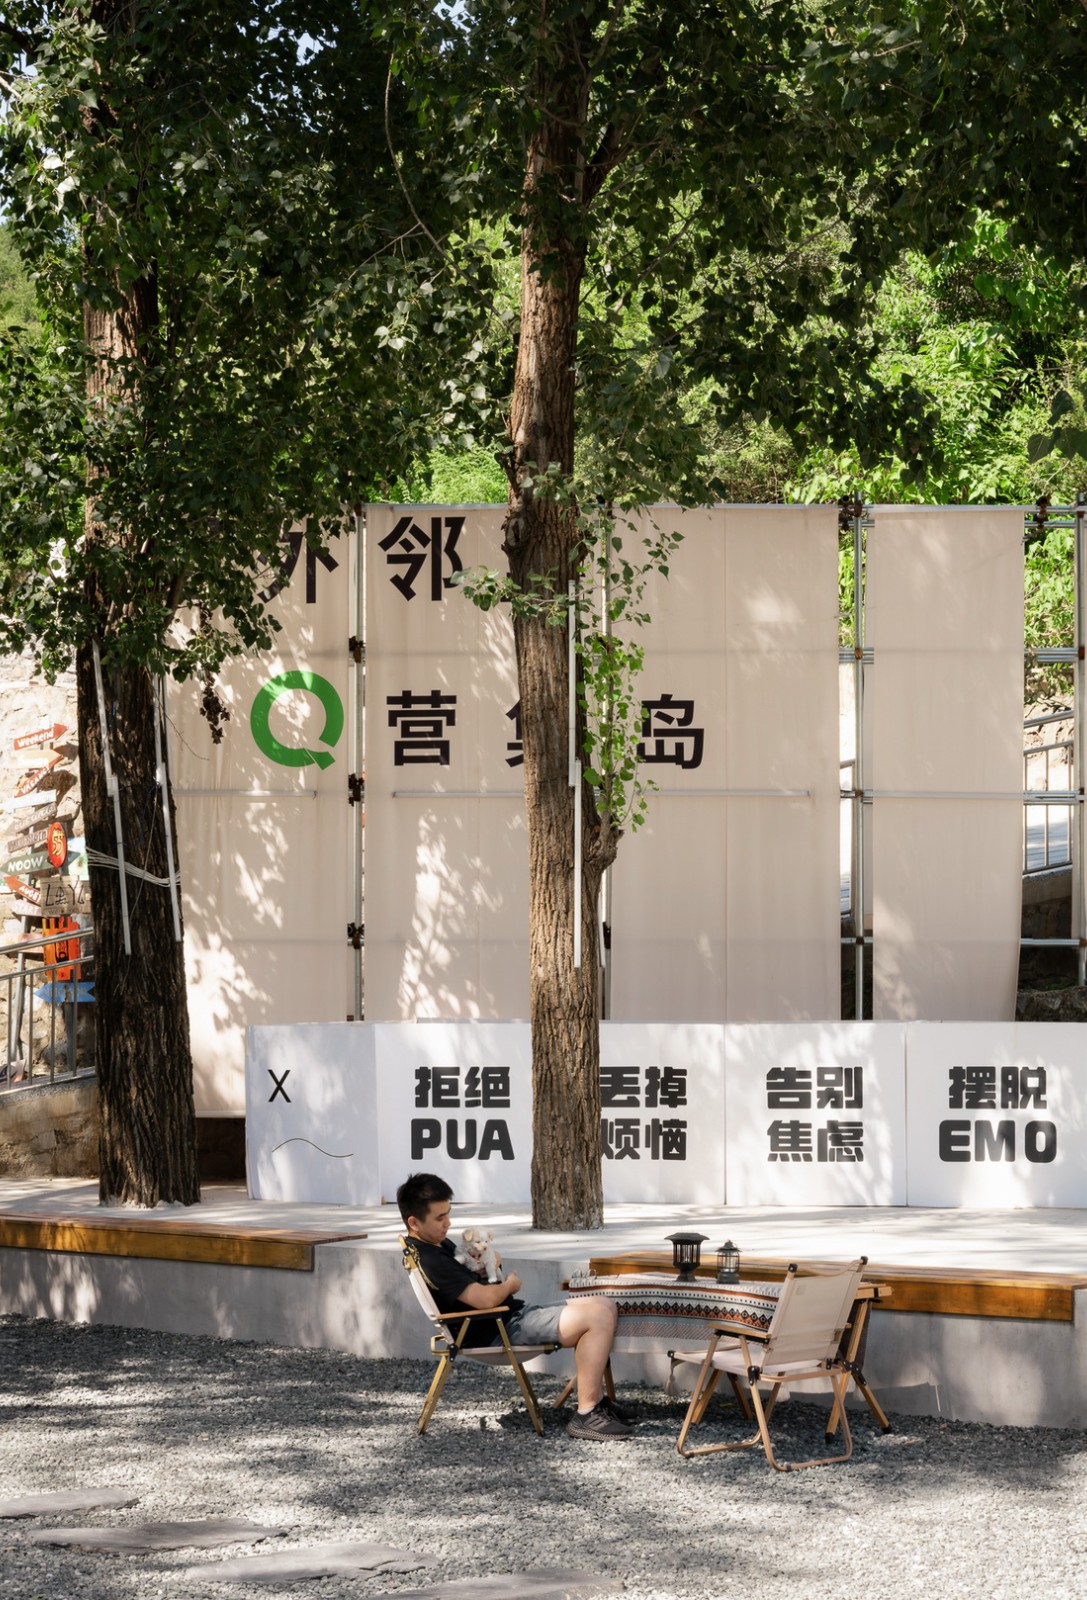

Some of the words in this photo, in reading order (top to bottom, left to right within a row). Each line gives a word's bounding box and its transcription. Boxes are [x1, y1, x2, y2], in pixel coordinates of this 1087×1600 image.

[16, 727, 54, 747] Weekend
[386, 689, 705, 770] 营岛
[414, 1066, 511, 1109] 拒绝
[600, 1066, 688, 1109] 丢掉
[766, 1066, 864, 1110] 告别
[949, 1065, 1048, 1110] 摆脱
[410, 1118, 516, 1161] PUA
[601, 1117, 688, 1161] 烦恼
[766, 1119, 865, 1163] 焦虑
[938, 1119, 1058, 1164] EMO
